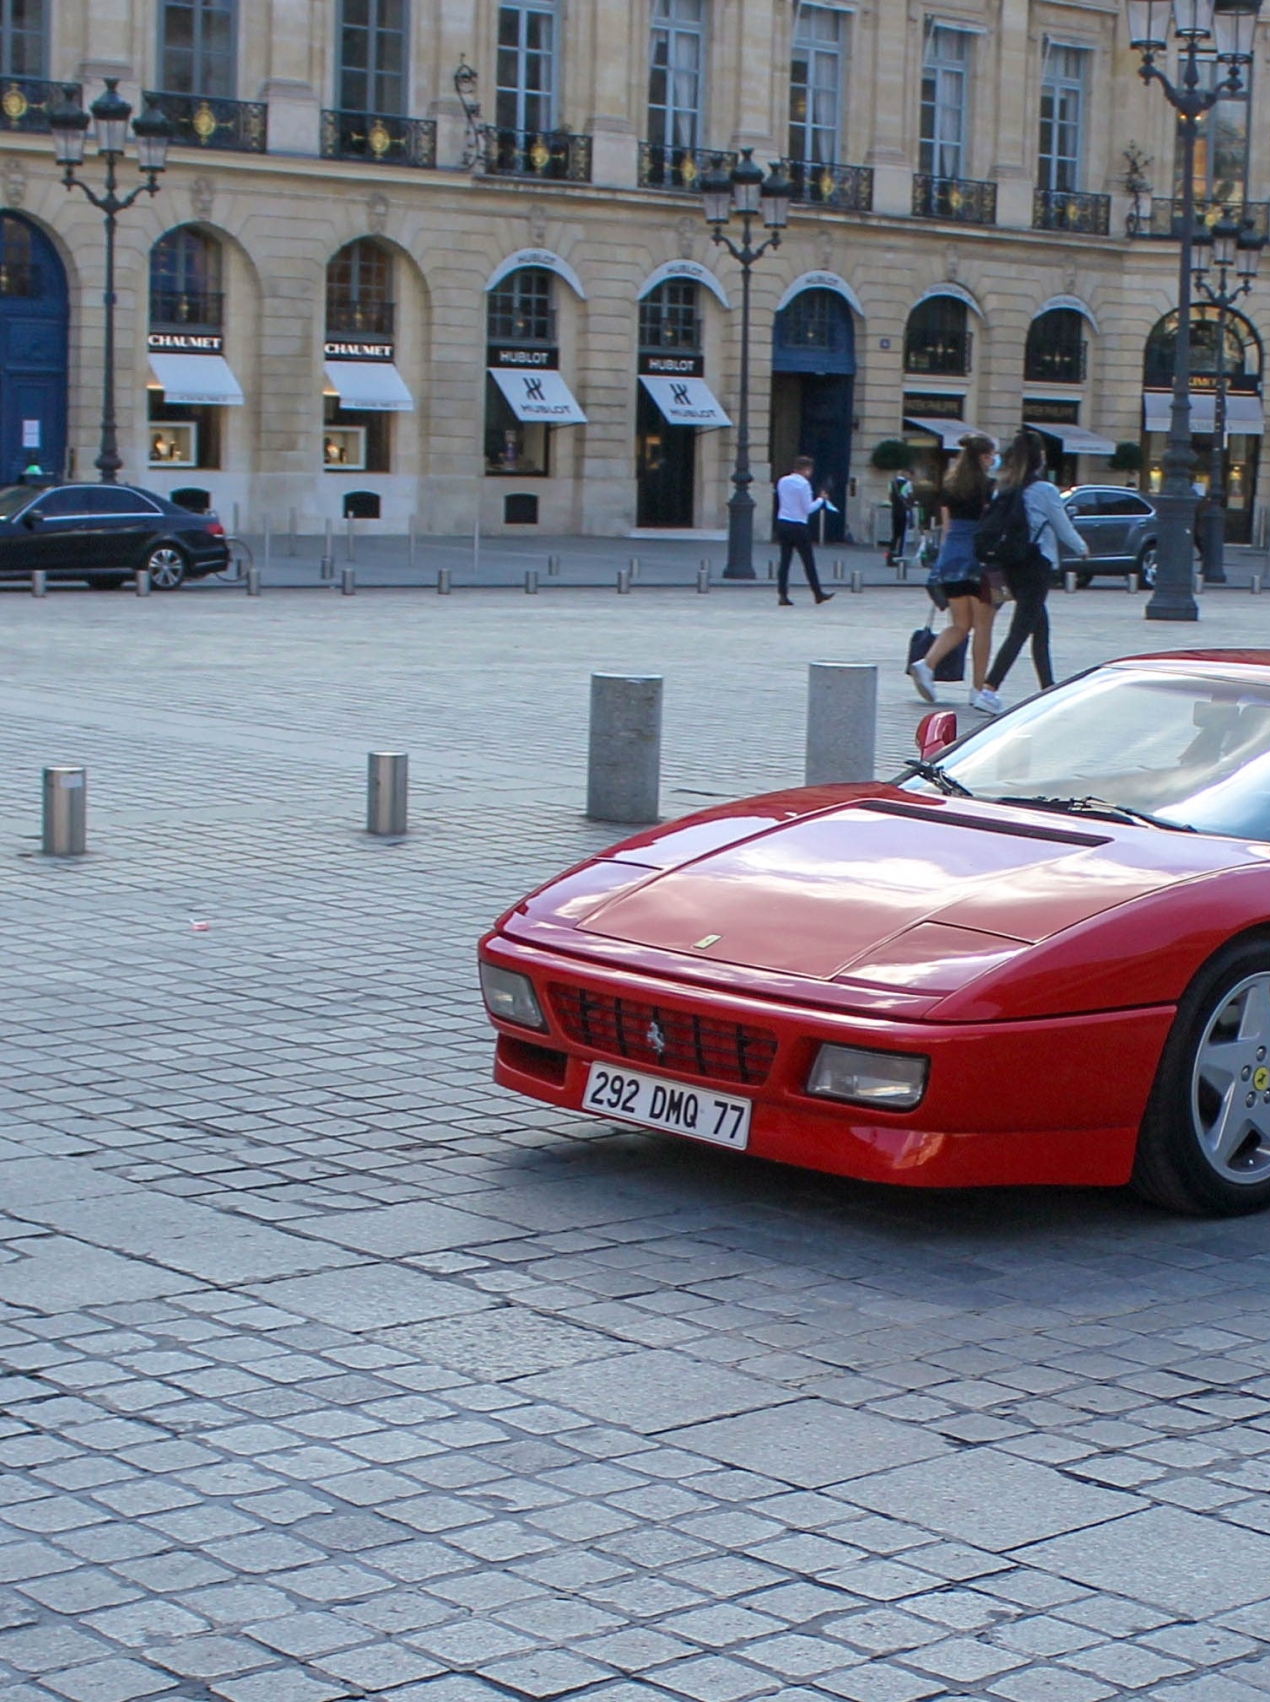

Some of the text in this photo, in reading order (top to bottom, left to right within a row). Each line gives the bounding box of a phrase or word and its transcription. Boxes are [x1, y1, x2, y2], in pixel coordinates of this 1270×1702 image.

[148, 334, 221, 349] CHAUMET
[324, 343, 392, 357] CHAUMET
[500, 350, 548, 365] HUBLOT
[649, 357, 695, 372] HUBLOT
[520, 402, 572, 415] HUBLOT
[669, 407, 718, 419] HUBLOT
[590, 1071, 745, 1140] 292 DMQ 77
